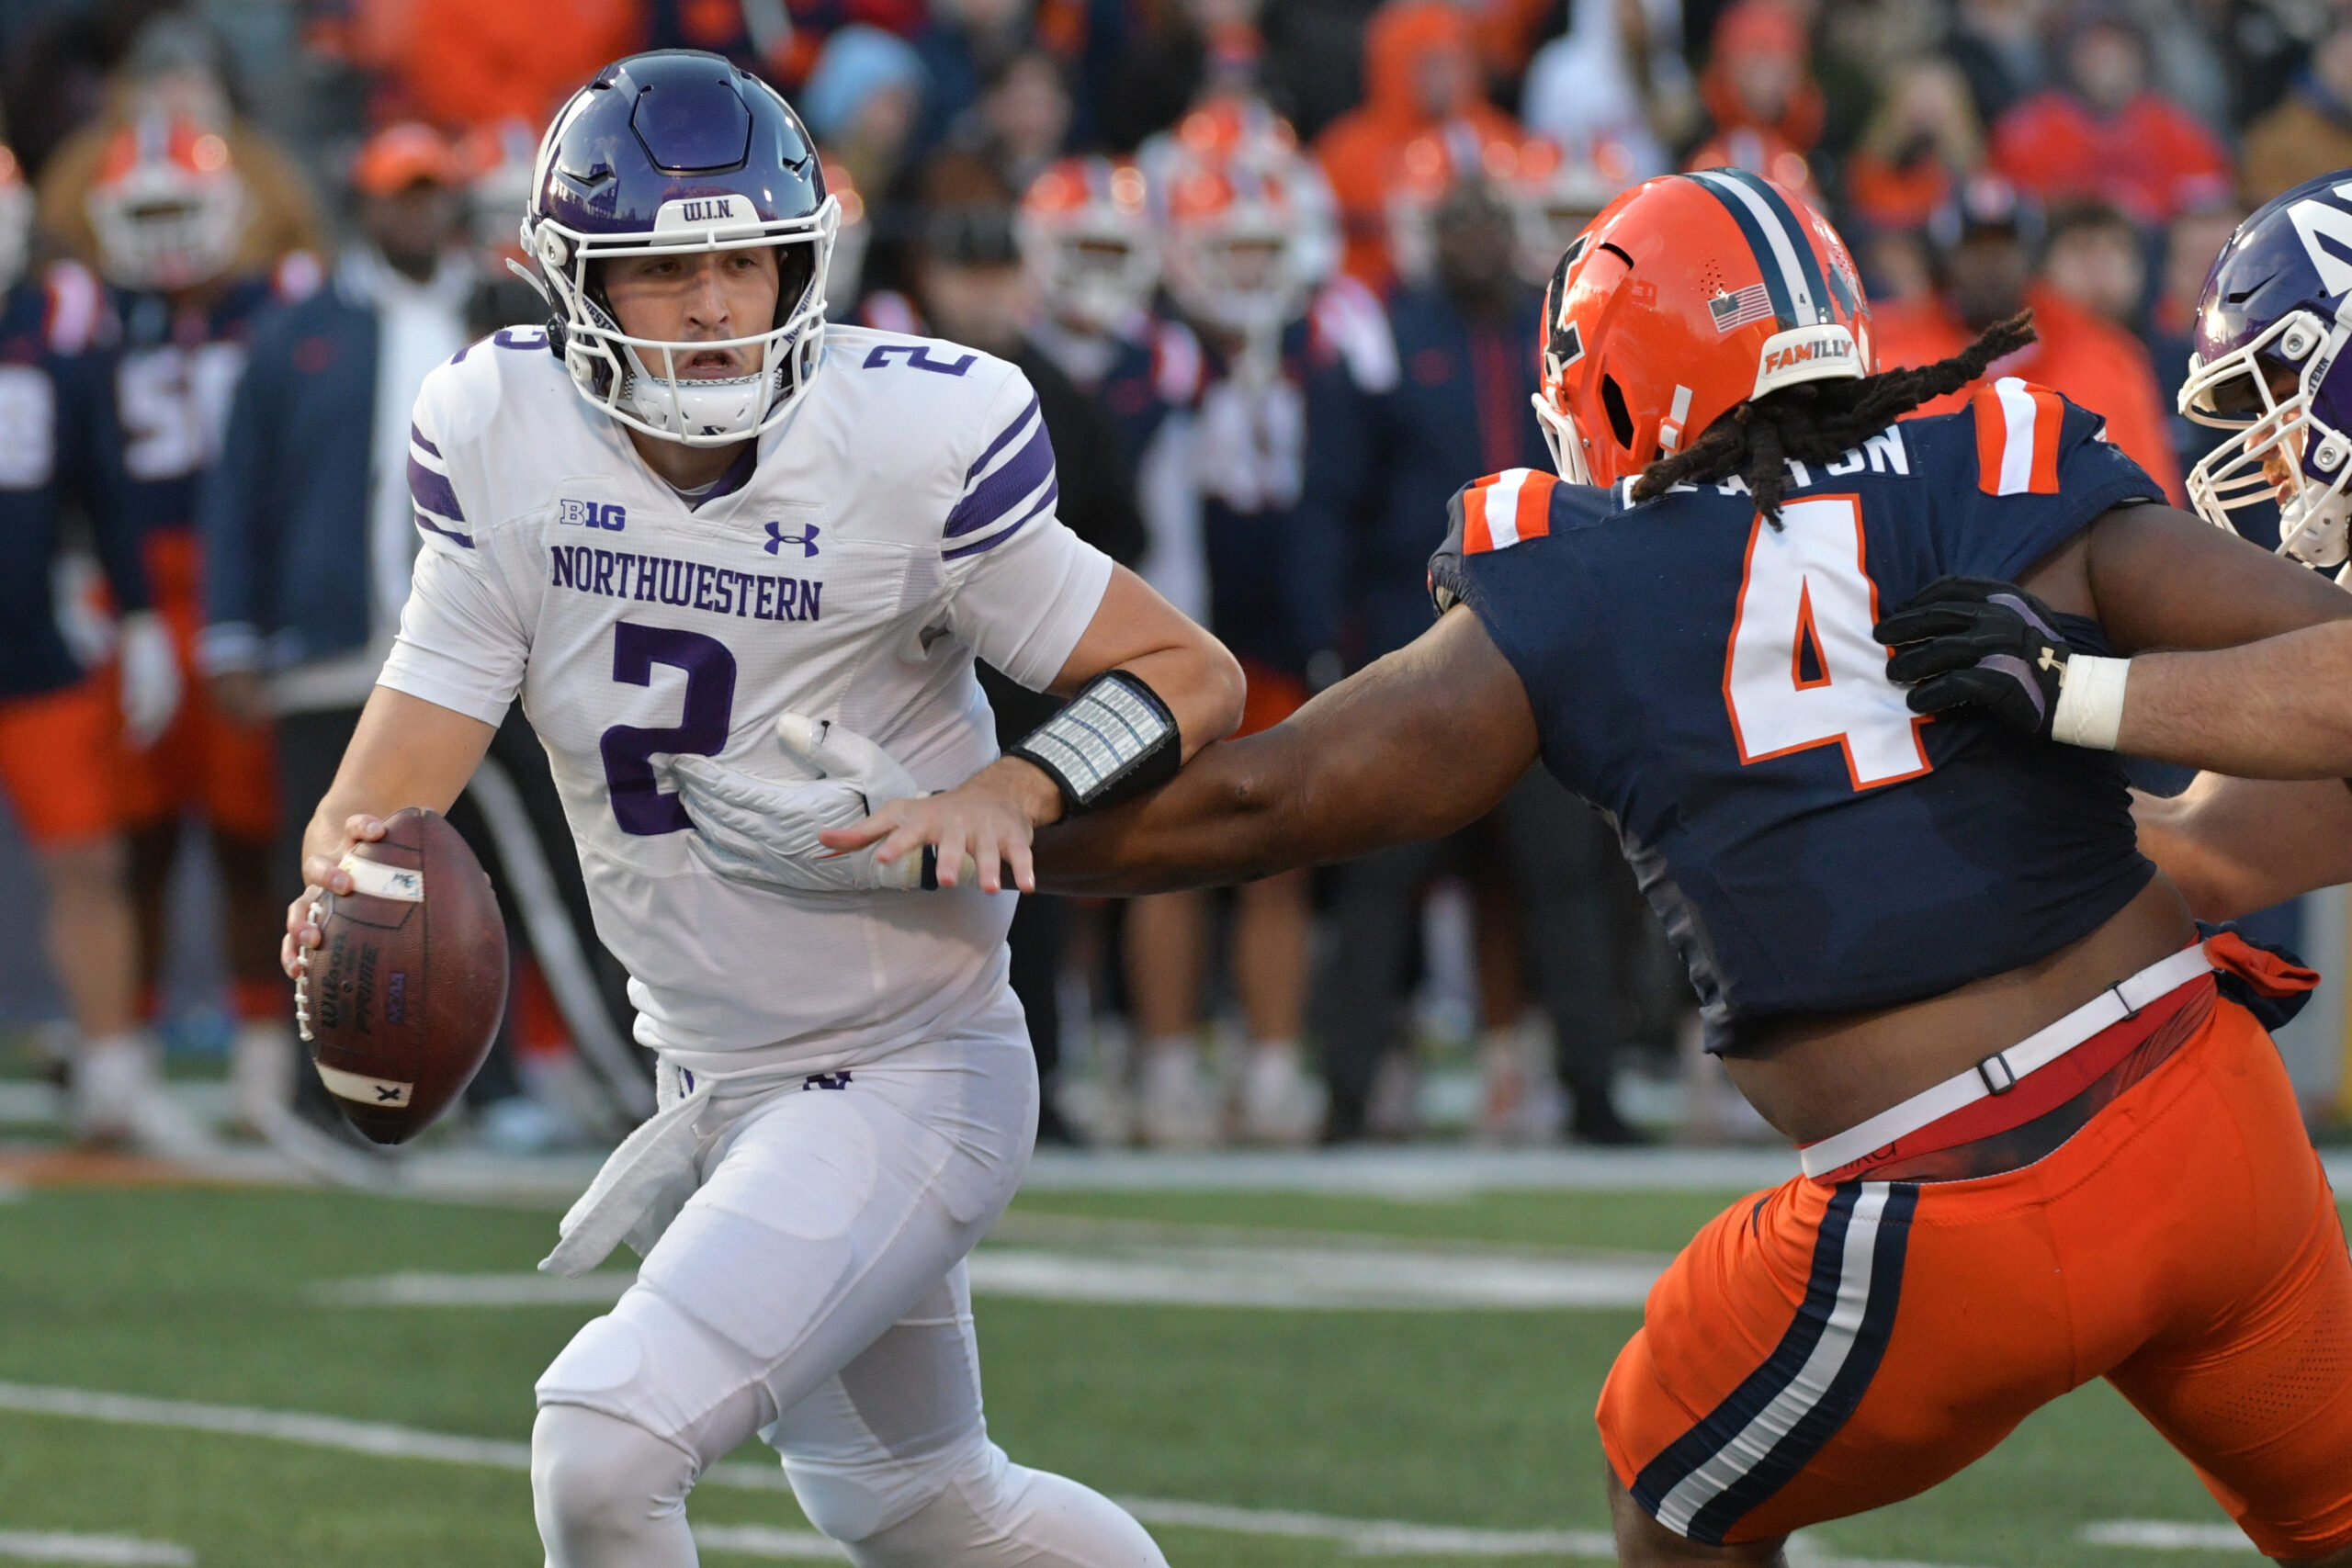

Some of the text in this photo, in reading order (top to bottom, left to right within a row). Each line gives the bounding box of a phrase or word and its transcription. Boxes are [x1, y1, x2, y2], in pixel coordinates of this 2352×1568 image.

[683, 199, 734, 222] W.I.N.
[1798, 292, 1807, 305] 4
[862, 344, 978, 378] 2
[1764, 339, 1853, 376] FAMILLY
[551, 546, 823, 622] NORTHWESTERN
[1722, 492, 1936, 793] 4
[600, 621, 738, 836] 2
